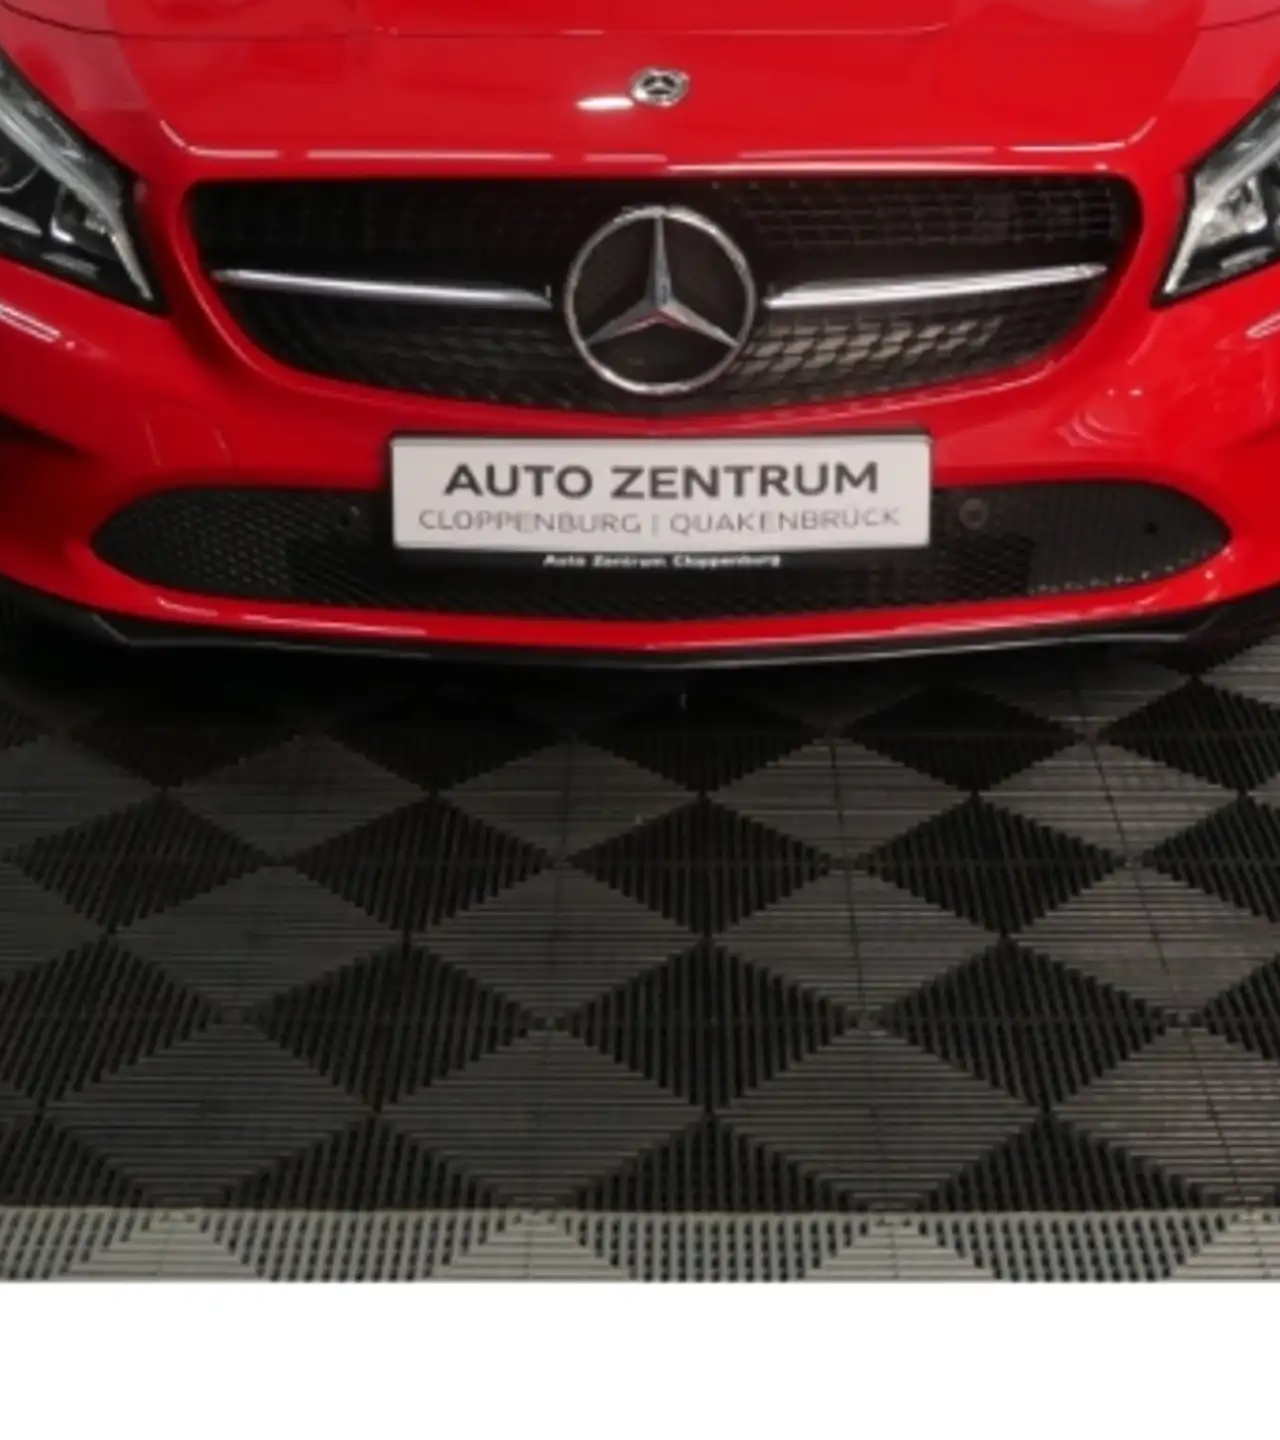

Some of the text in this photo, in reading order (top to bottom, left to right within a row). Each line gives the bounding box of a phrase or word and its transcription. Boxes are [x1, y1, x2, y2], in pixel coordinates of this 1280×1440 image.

[442, 459, 879, 501] AUTO ZENTRUM
[418, 509, 642, 535] CLOPPENBURG
[669, 506, 900, 538] QUAKENBRÜCK
[542, 553, 781, 571] Auto Zentrum Cloppenburg
